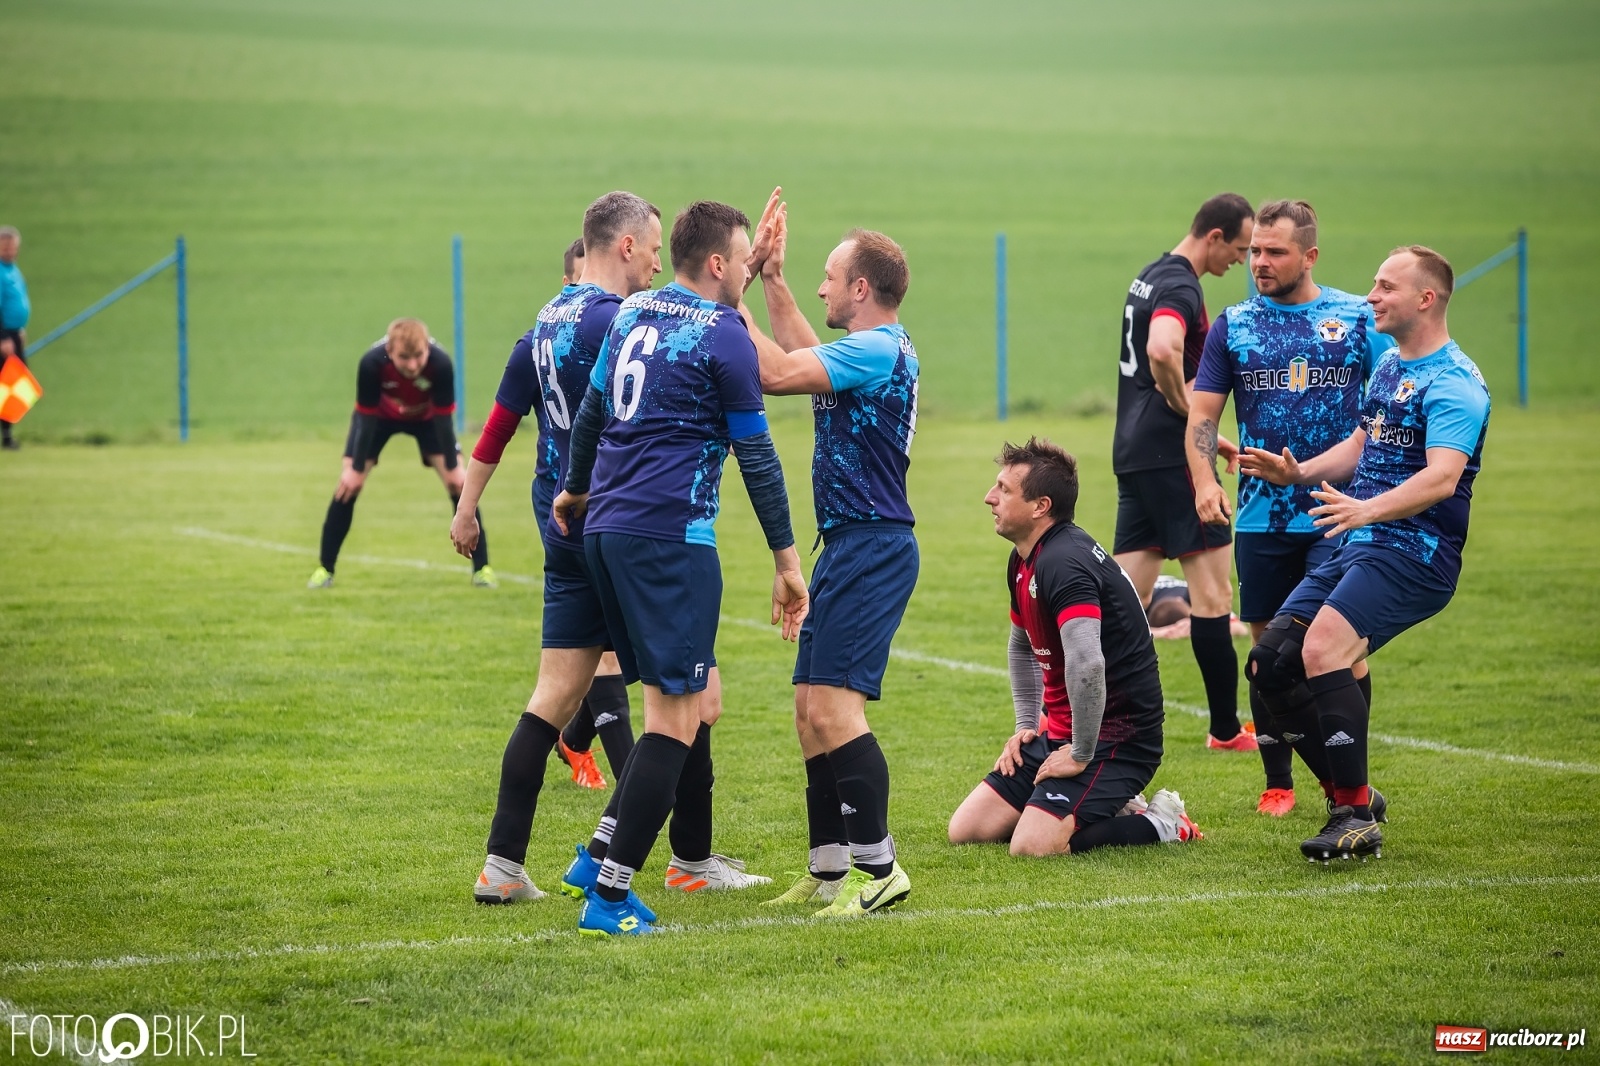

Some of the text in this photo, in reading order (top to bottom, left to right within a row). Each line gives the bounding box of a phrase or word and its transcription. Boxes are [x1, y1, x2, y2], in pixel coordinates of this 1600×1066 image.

[612, 325, 659, 422] 6
[1119, 304, 1139, 377] 3
[1240, 356, 1352, 392] REICHBAU
